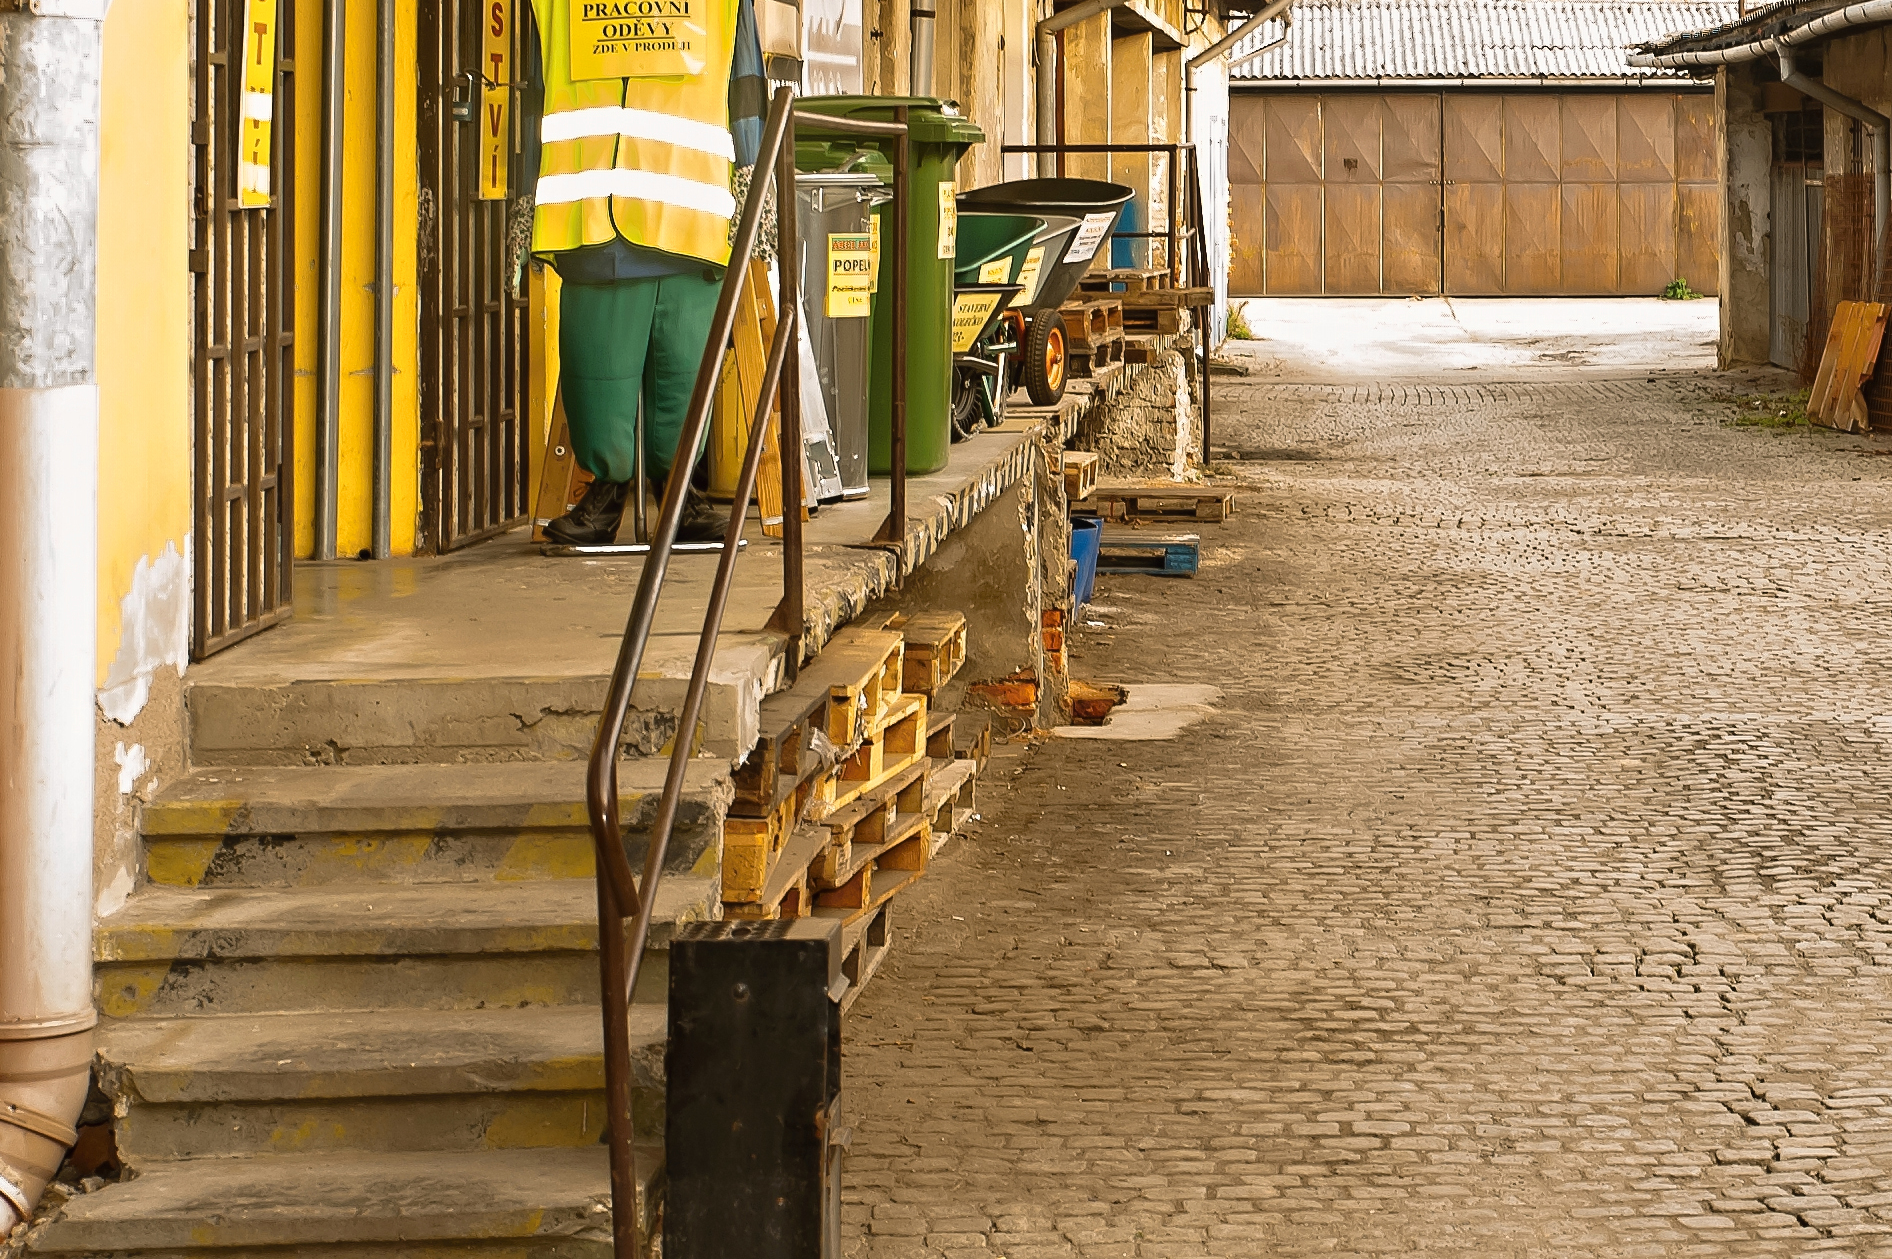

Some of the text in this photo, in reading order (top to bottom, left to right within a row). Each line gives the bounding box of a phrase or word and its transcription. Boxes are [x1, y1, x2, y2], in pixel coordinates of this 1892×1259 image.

[602, 18, 675, 38] ODĚVY
[592, 43, 619, 55] ZDE
[622, 43, 631, 52] V
